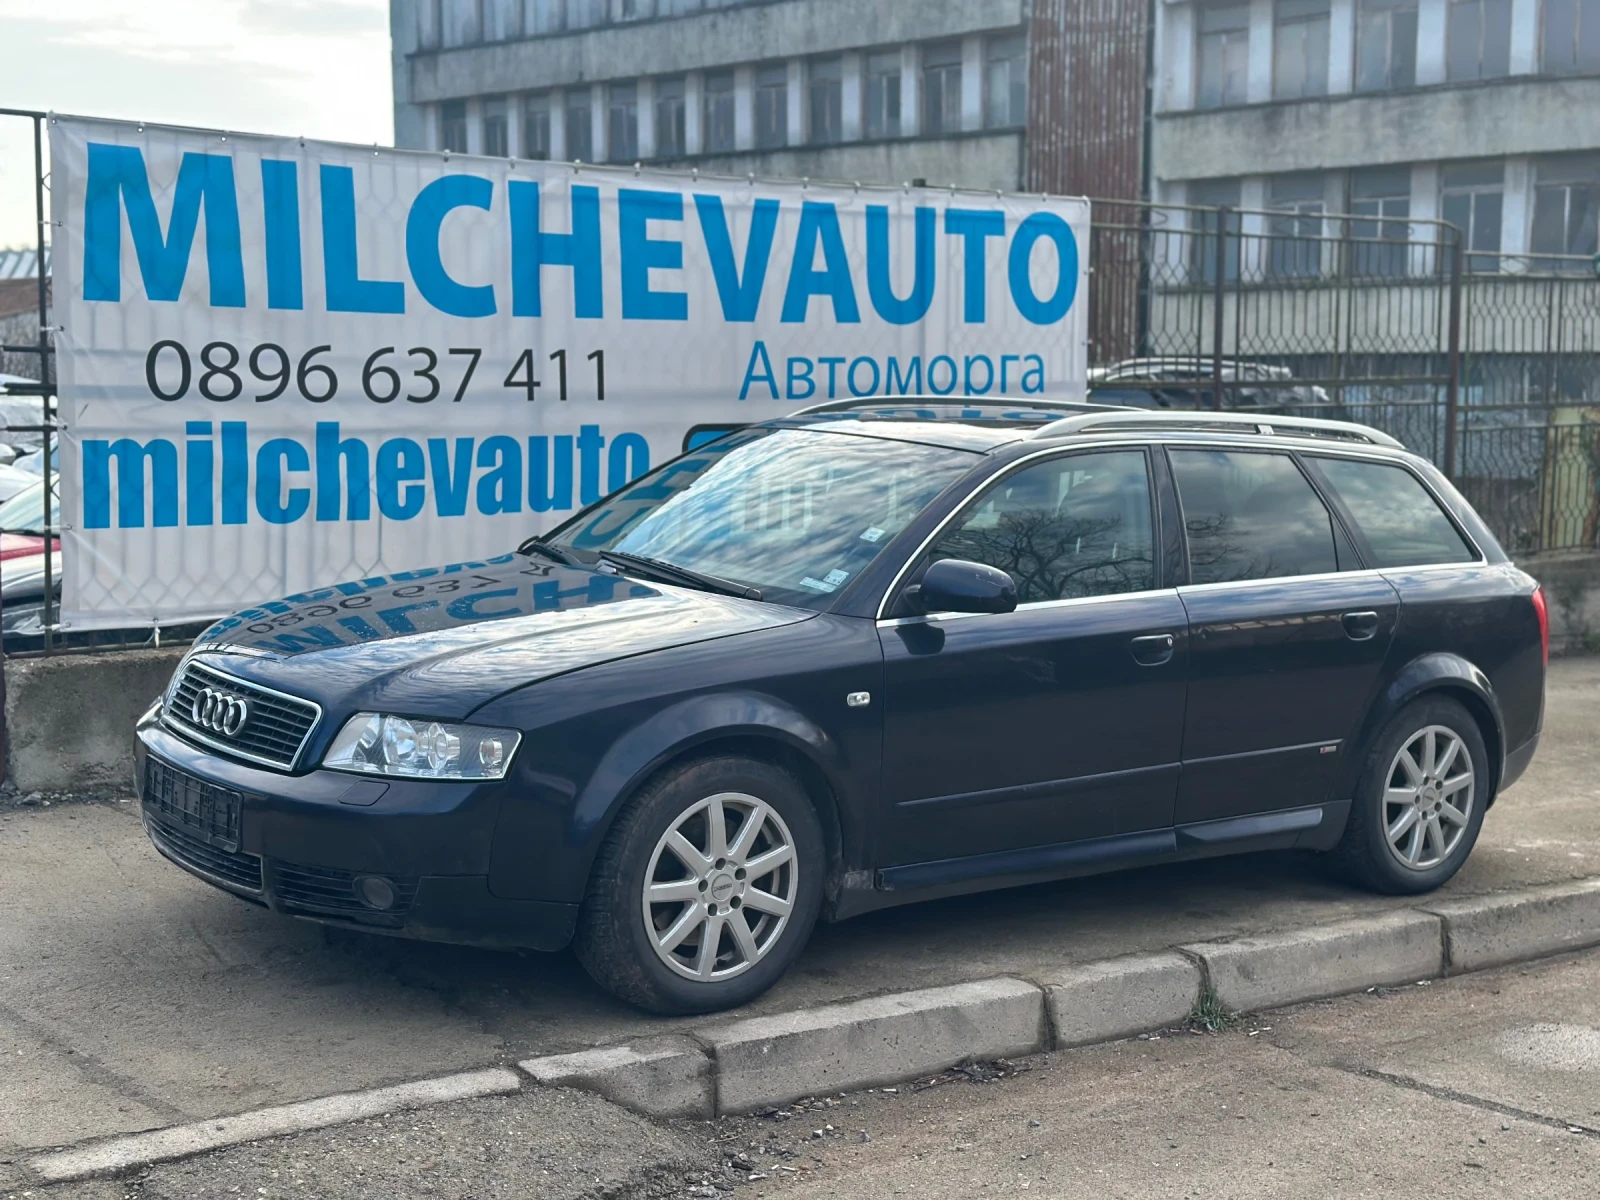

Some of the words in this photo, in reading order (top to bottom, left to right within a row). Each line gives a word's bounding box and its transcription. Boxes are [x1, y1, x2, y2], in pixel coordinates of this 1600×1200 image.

[84, 141, 1079, 325] MILCHEVAUTO
[145, 340, 338, 403] 0896
[361, 346, 482, 403] 637
[503, 349, 606, 402] 411
[738, 340, 1045, 398] Автоморга
[81, 421, 650, 529] milchevauto
